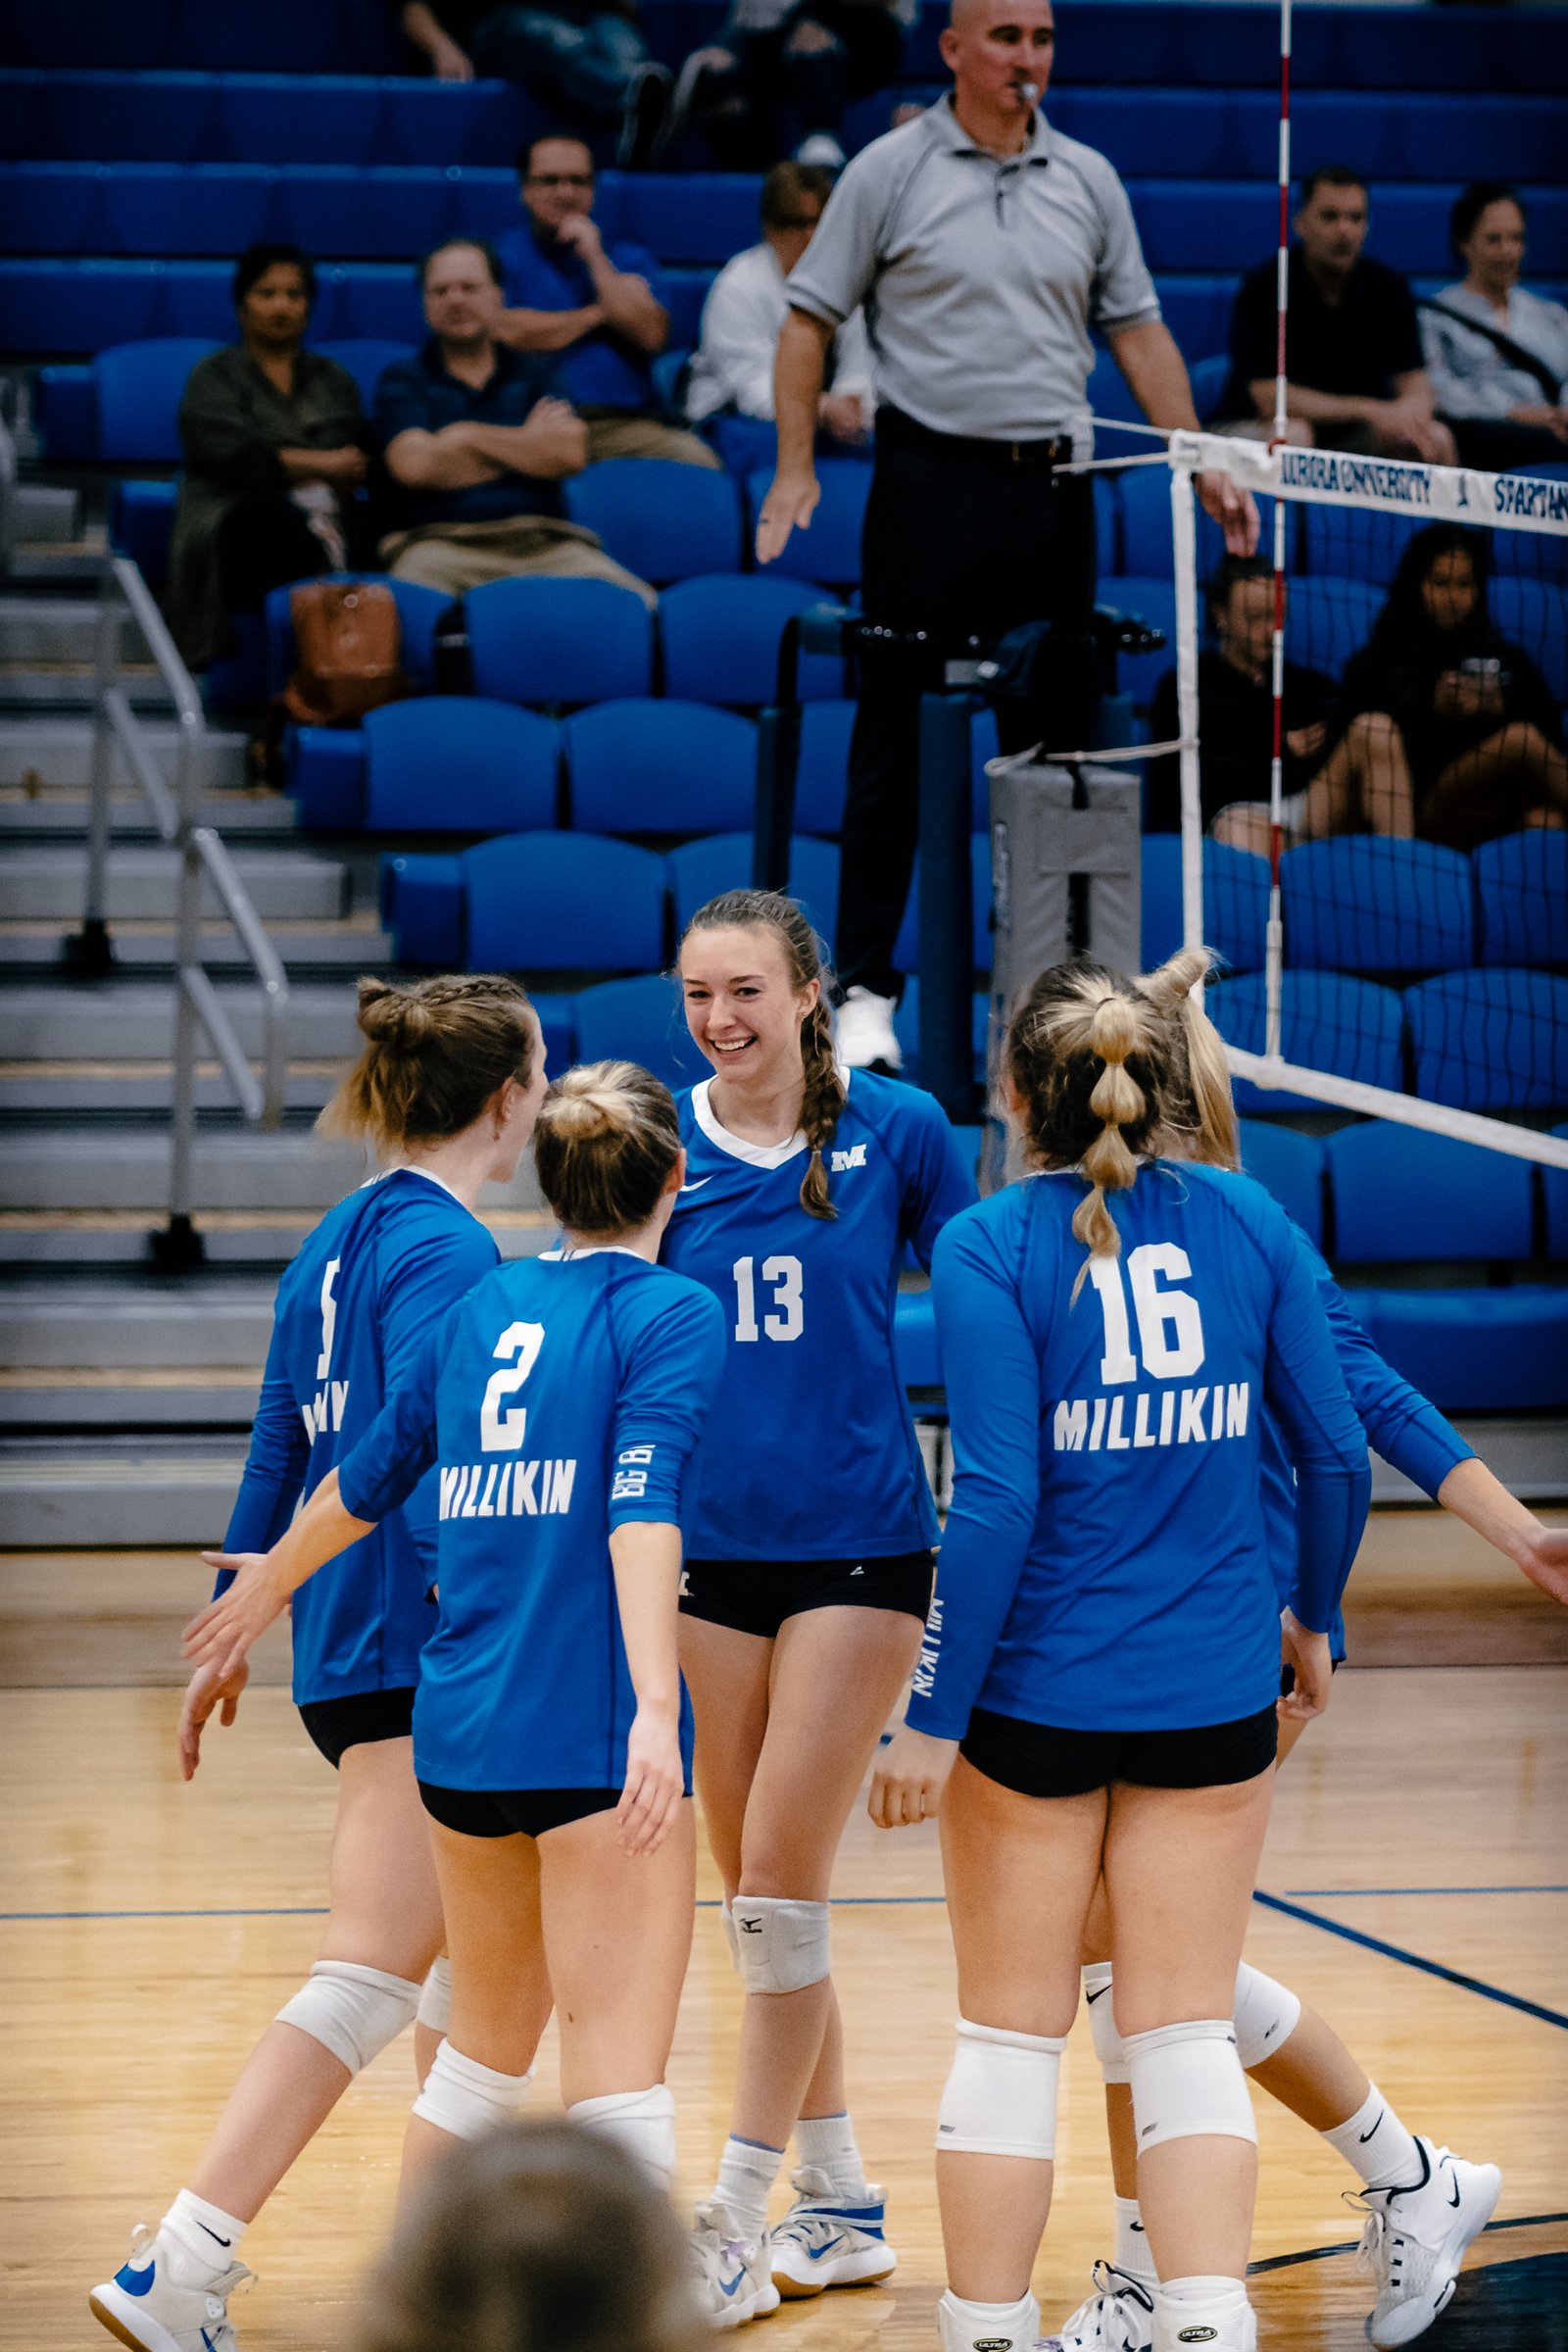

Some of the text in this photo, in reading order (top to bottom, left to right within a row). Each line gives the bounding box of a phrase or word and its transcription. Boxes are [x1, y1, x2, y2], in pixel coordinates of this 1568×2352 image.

[831, 1144, 866, 1172] M
[733, 1255, 804, 1342] 13
[1090, 1242, 1205, 1385] 16
[480, 1321, 545, 1452] 2
[1054, 1382, 1250, 1451] MILLIKIN
